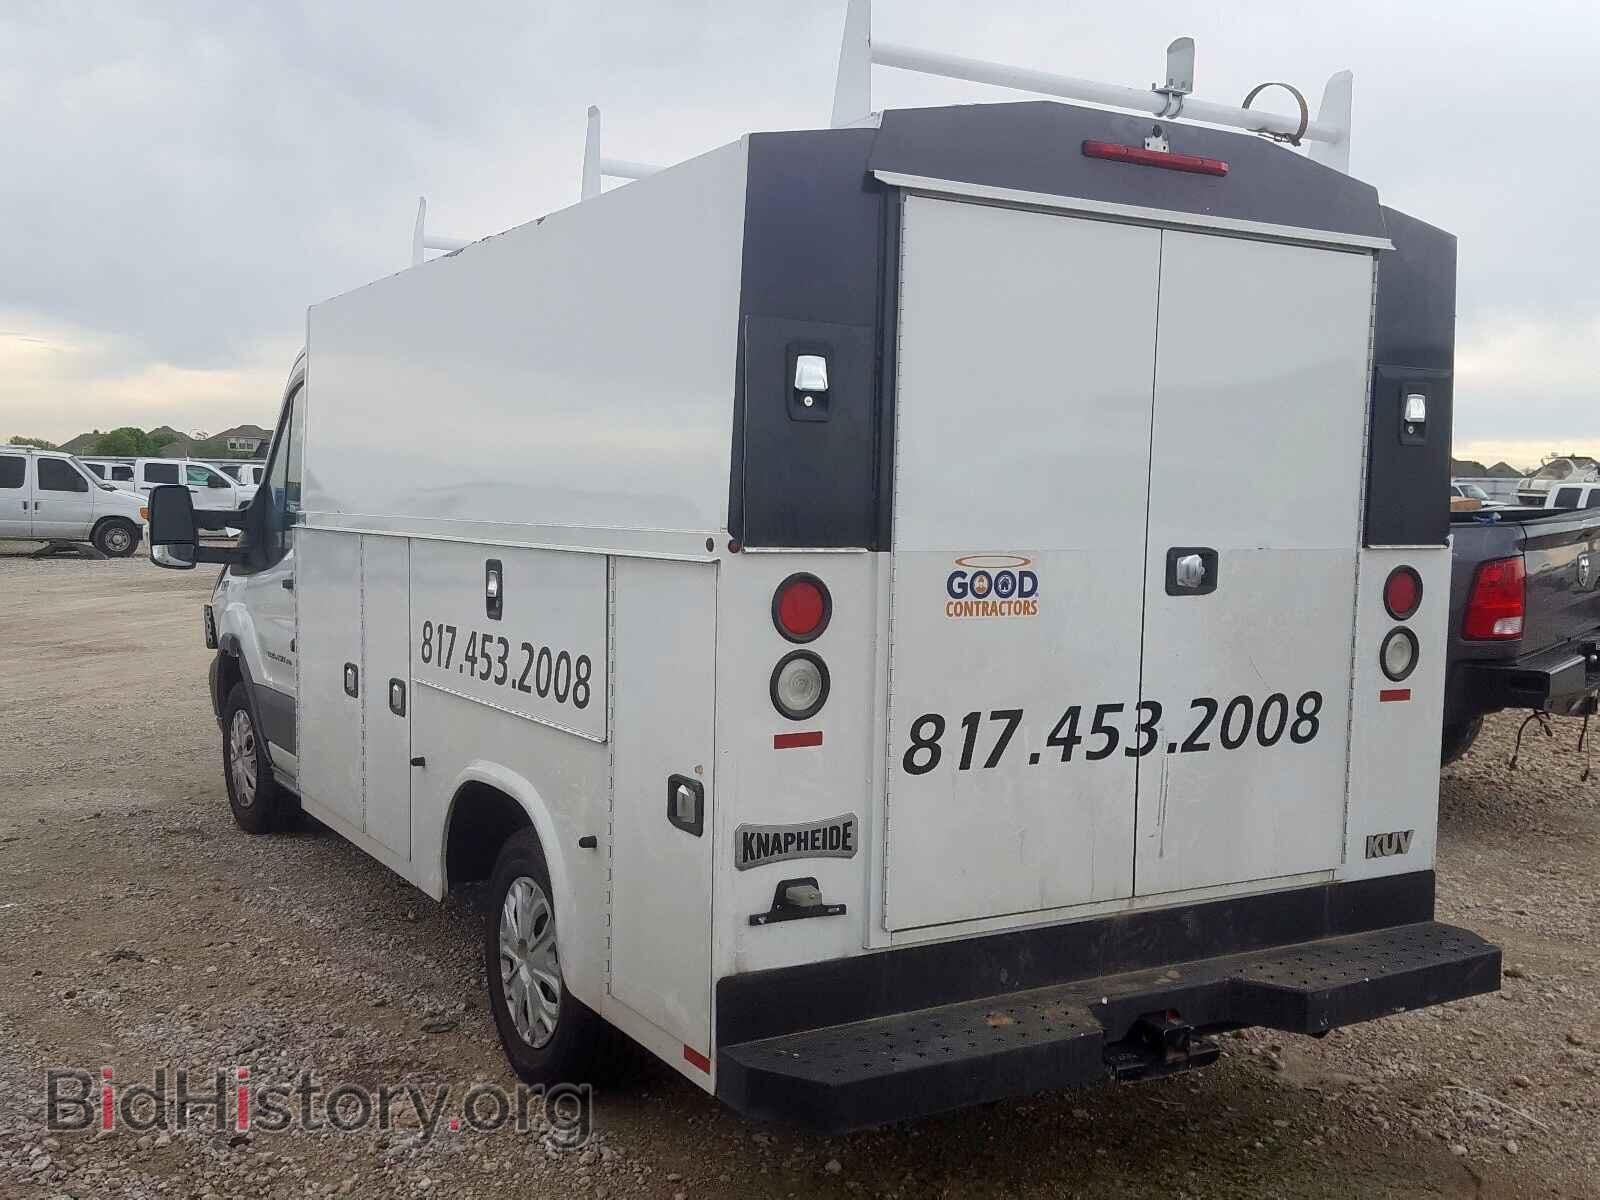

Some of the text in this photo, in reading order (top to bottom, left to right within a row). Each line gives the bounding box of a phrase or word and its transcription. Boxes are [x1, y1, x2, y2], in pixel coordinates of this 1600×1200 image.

[946, 570, 1038, 599] GOOD
[946, 600, 1038, 617] CONTRACTORS
[421, 620, 592, 709] 817.453.2008
[902, 691, 1323, 775] 817.453.2008
[742, 820, 853, 863] KNAPHEIDE
[1365, 830, 1414, 859] KUV
